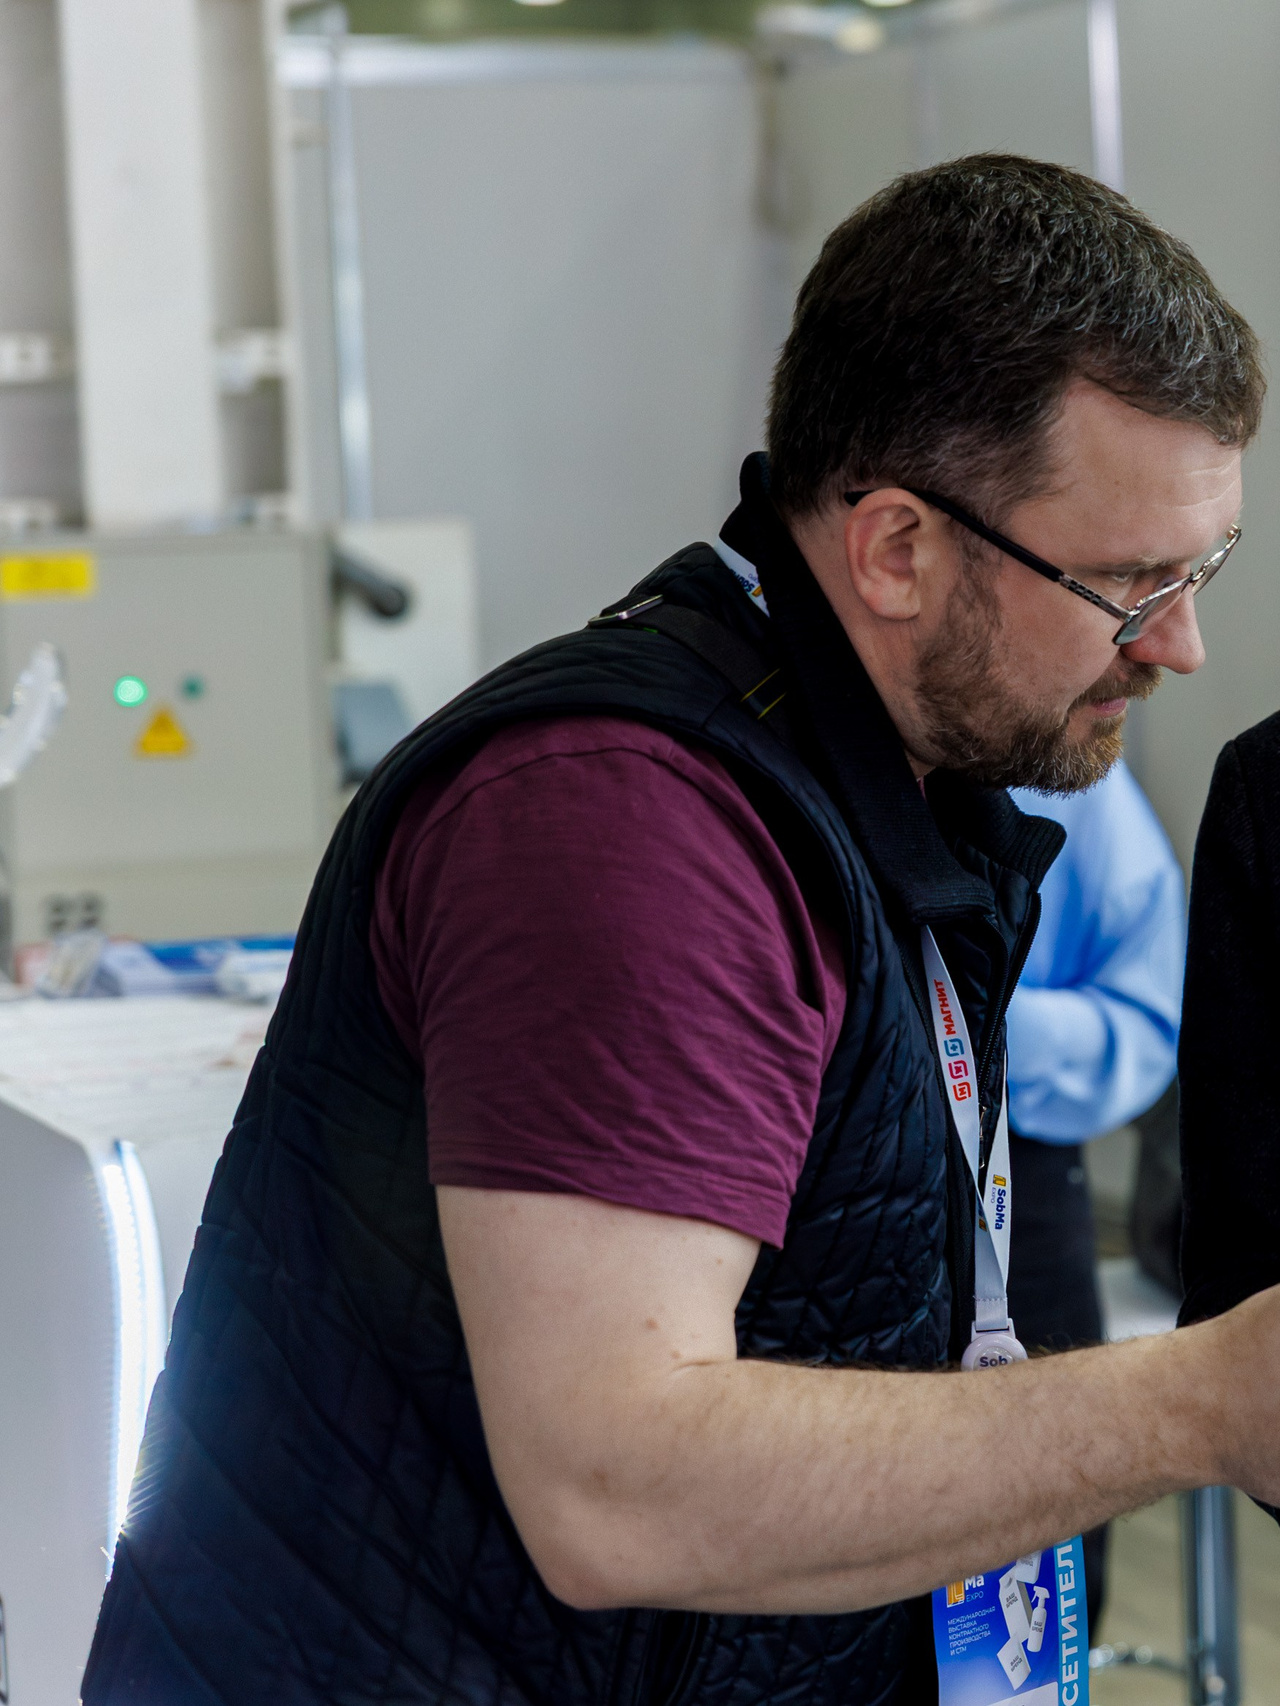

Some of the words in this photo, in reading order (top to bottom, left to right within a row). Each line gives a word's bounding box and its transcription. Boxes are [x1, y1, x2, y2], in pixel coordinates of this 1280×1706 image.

[934, 979, 956, 1035] МАГНИТ
[995, 1188, 1006, 1230] SobMa
[979, 1355, 1008, 1367] Sob
[965, 1574, 985, 1591] Ma
[966, 1591, 984, 1602] EXPO
